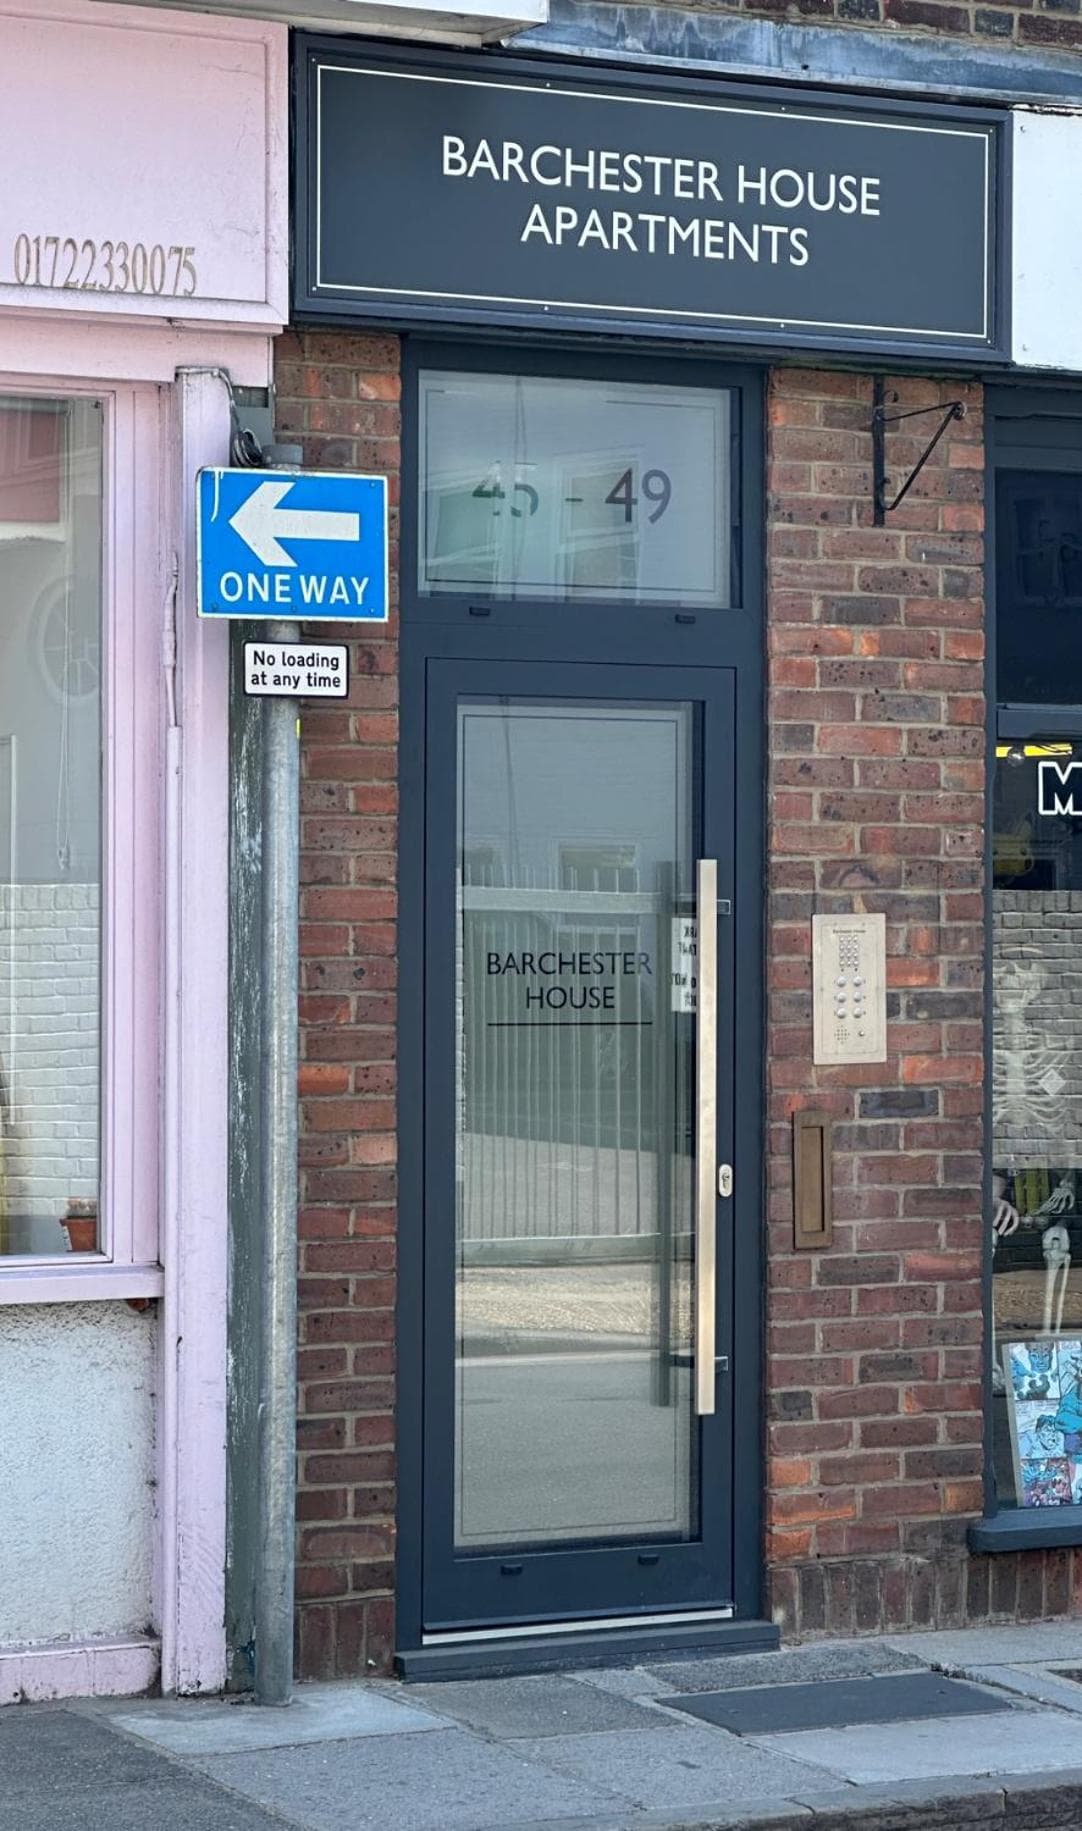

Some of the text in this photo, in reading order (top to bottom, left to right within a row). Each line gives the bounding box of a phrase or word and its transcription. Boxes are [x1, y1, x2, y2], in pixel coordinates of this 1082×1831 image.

[443, 135, 880, 216] BARCHESTER HOUSE
[520, 203, 809, 266] APARTMENTS
[14, 233, 197, 298] 01722330075
[604, 467, 672, 525] 49
[220, 571, 369, 605] ONE WAY
[253, 650, 339, 670] No loading
[251, 671, 341, 689] at any time
[487, 952, 653, 975] BARCHESTER
[526, 986, 615, 1009] HOUSE
